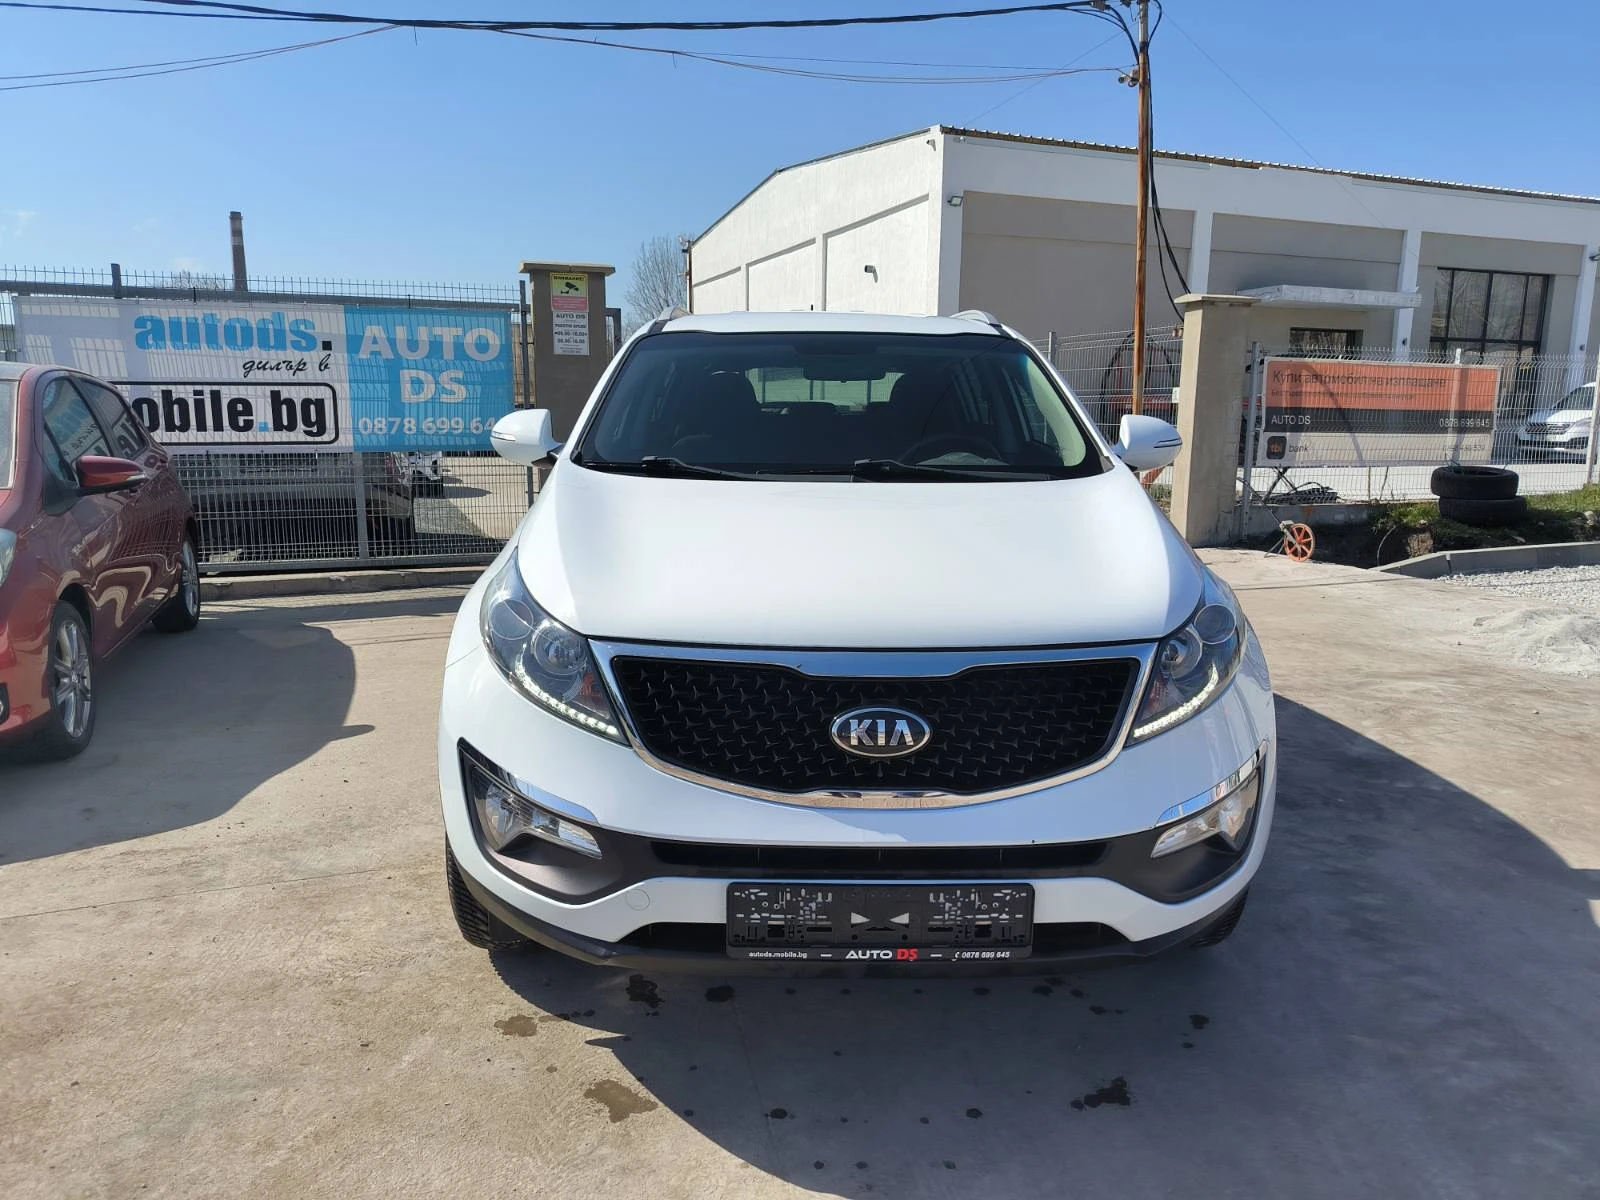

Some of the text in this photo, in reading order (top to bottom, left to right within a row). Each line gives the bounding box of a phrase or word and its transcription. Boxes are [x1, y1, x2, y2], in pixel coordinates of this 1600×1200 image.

[134, 312, 333, 353] autods.
[358, 326, 501, 361] AUTO
[242, 353, 331, 378] дилър в
[1273, 370, 1302, 385] Купи
[400, 369, 467, 403] DS
[131, 389, 328, 437] obile.bg
[1271, 415, 1311, 425] AUTO DS
[358, 417, 496, 435] 0878 699 64
[1288, 445, 1309, 453] bank
[849, 719, 915, 746] KIA
[748, 948, 1010, 961] autods.mobile.bg AUTO DS 0878 699 645
